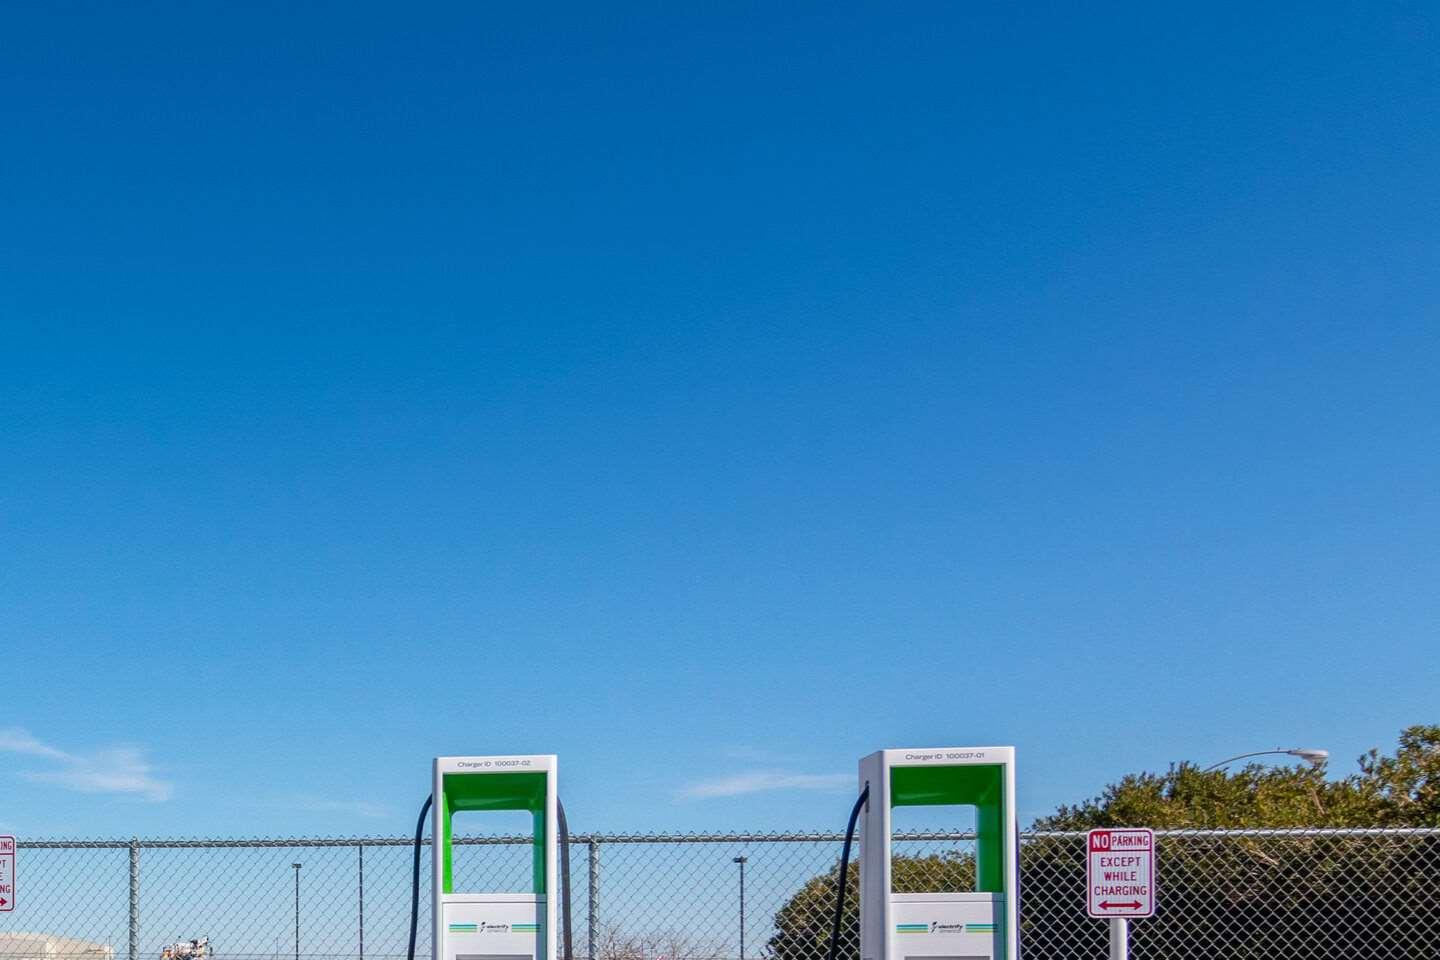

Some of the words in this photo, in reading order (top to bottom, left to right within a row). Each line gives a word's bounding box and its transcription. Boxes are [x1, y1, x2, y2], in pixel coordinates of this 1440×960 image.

[905, 753, 933, 761] Charger
[1092, 834, 1109, 849] NO
[1112, 835, 1149, 846] PARKING
[1100, 856, 1142, 867] EXCEPT
[1104, 871, 1137, 881] WHILE
[1094, 885, 1147, 896] CHARGING
